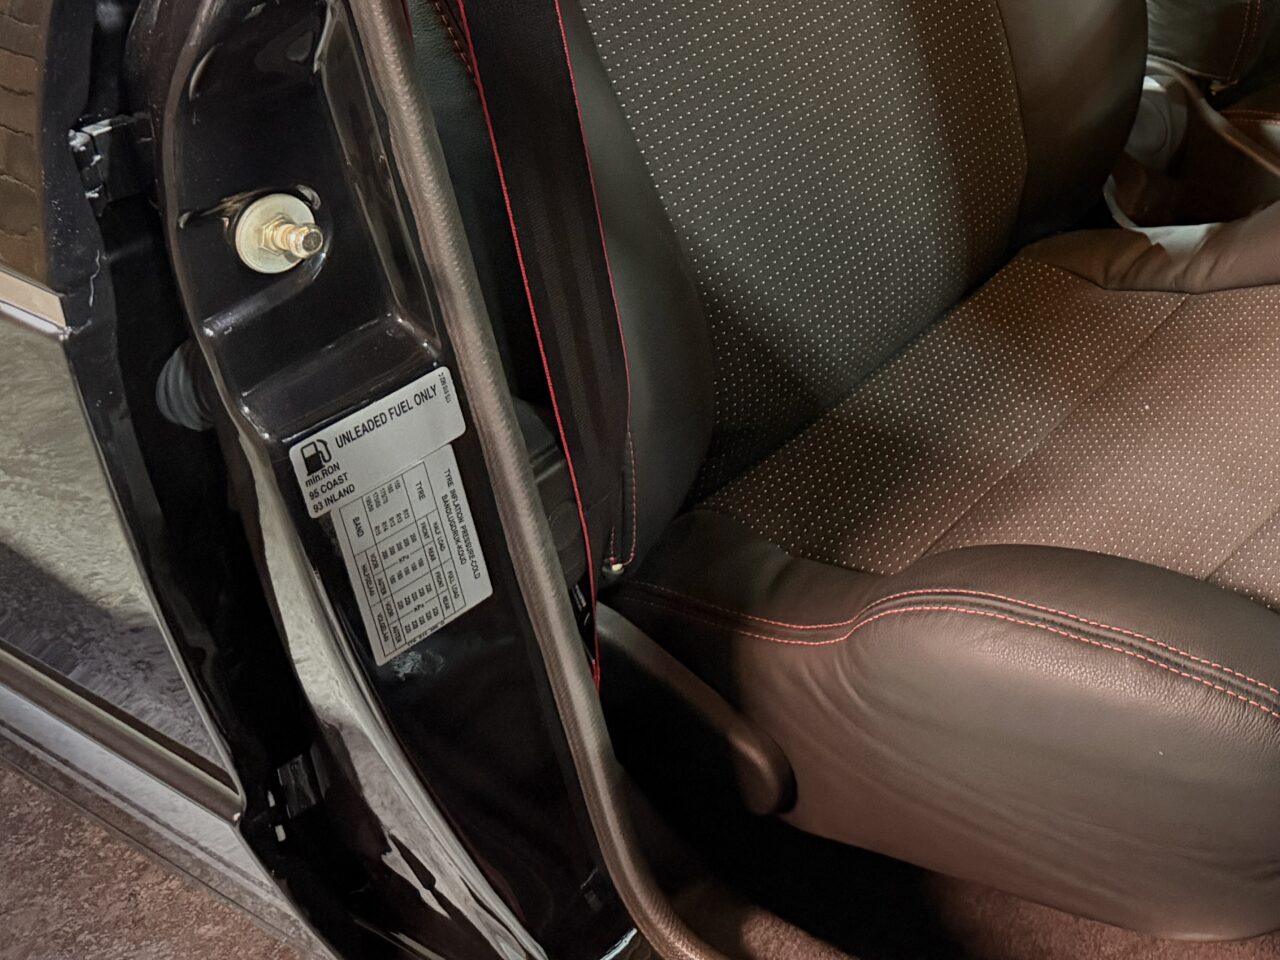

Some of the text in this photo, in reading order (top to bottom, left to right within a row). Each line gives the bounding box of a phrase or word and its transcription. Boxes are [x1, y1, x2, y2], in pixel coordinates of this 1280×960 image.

[335, 384, 436, 448] UNLEADED FUEL ONLY
[305, 462, 340, 487] min.RON
[309, 472, 348, 500] 95 COAST
[313, 484, 355, 513] 93 INLAND
[415, 481, 426, 501] TYRE
[444, 468, 454, 487] TYRE
[449, 489, 464, 523] INFLATION
[352, 516, 364, 538] BAND
[437, 536, 445, 552] LOAD
[451, 584, 460, 599] LOAD
